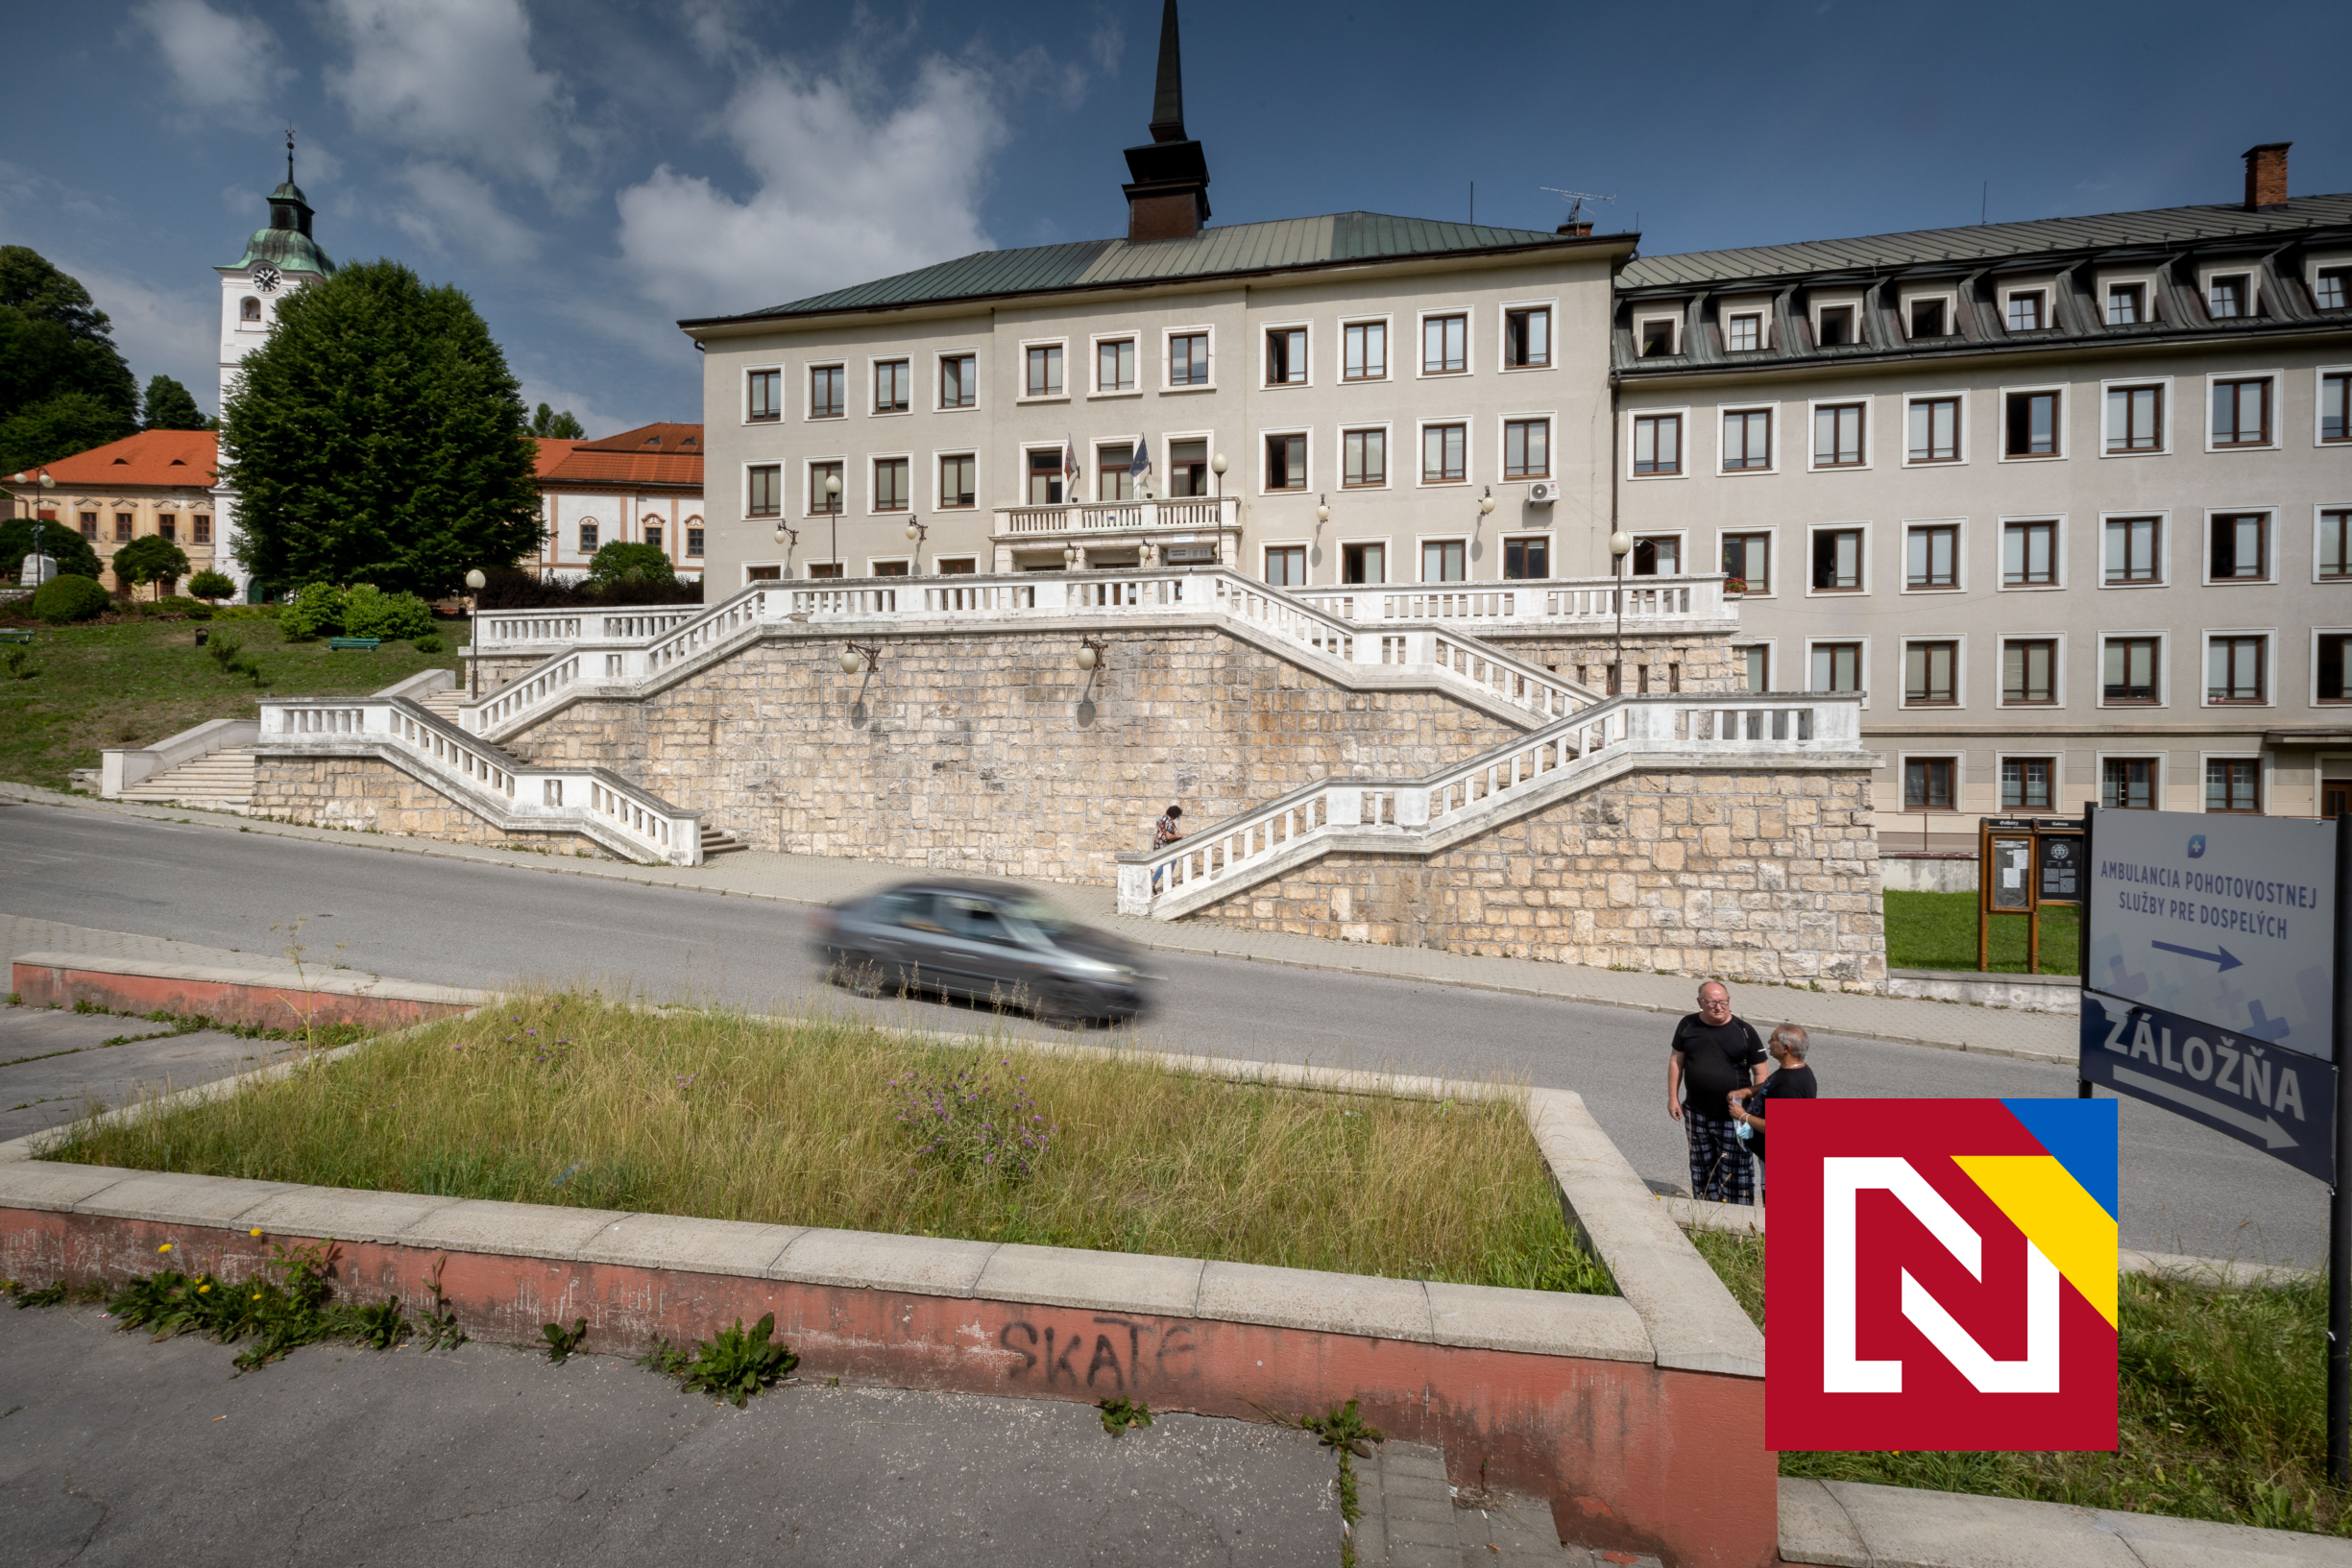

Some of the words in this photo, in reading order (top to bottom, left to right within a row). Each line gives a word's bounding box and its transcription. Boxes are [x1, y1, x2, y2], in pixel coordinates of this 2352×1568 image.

[2100, 860, 2180, 889] AMBULANCIA
[2186, 871, 2317, 909] POHOTOVOSTNEJ
[2119, 891, 2165, 916] SLUŽBY
[2170, 900, 2194, 922] PRE
[2200, 905, 2288, 940] DOSPELÝCH
[2104, 1011, 2306, 1122] ZÁLOŽŇA
[1000, 1316, 1200, 1390] SKATE
